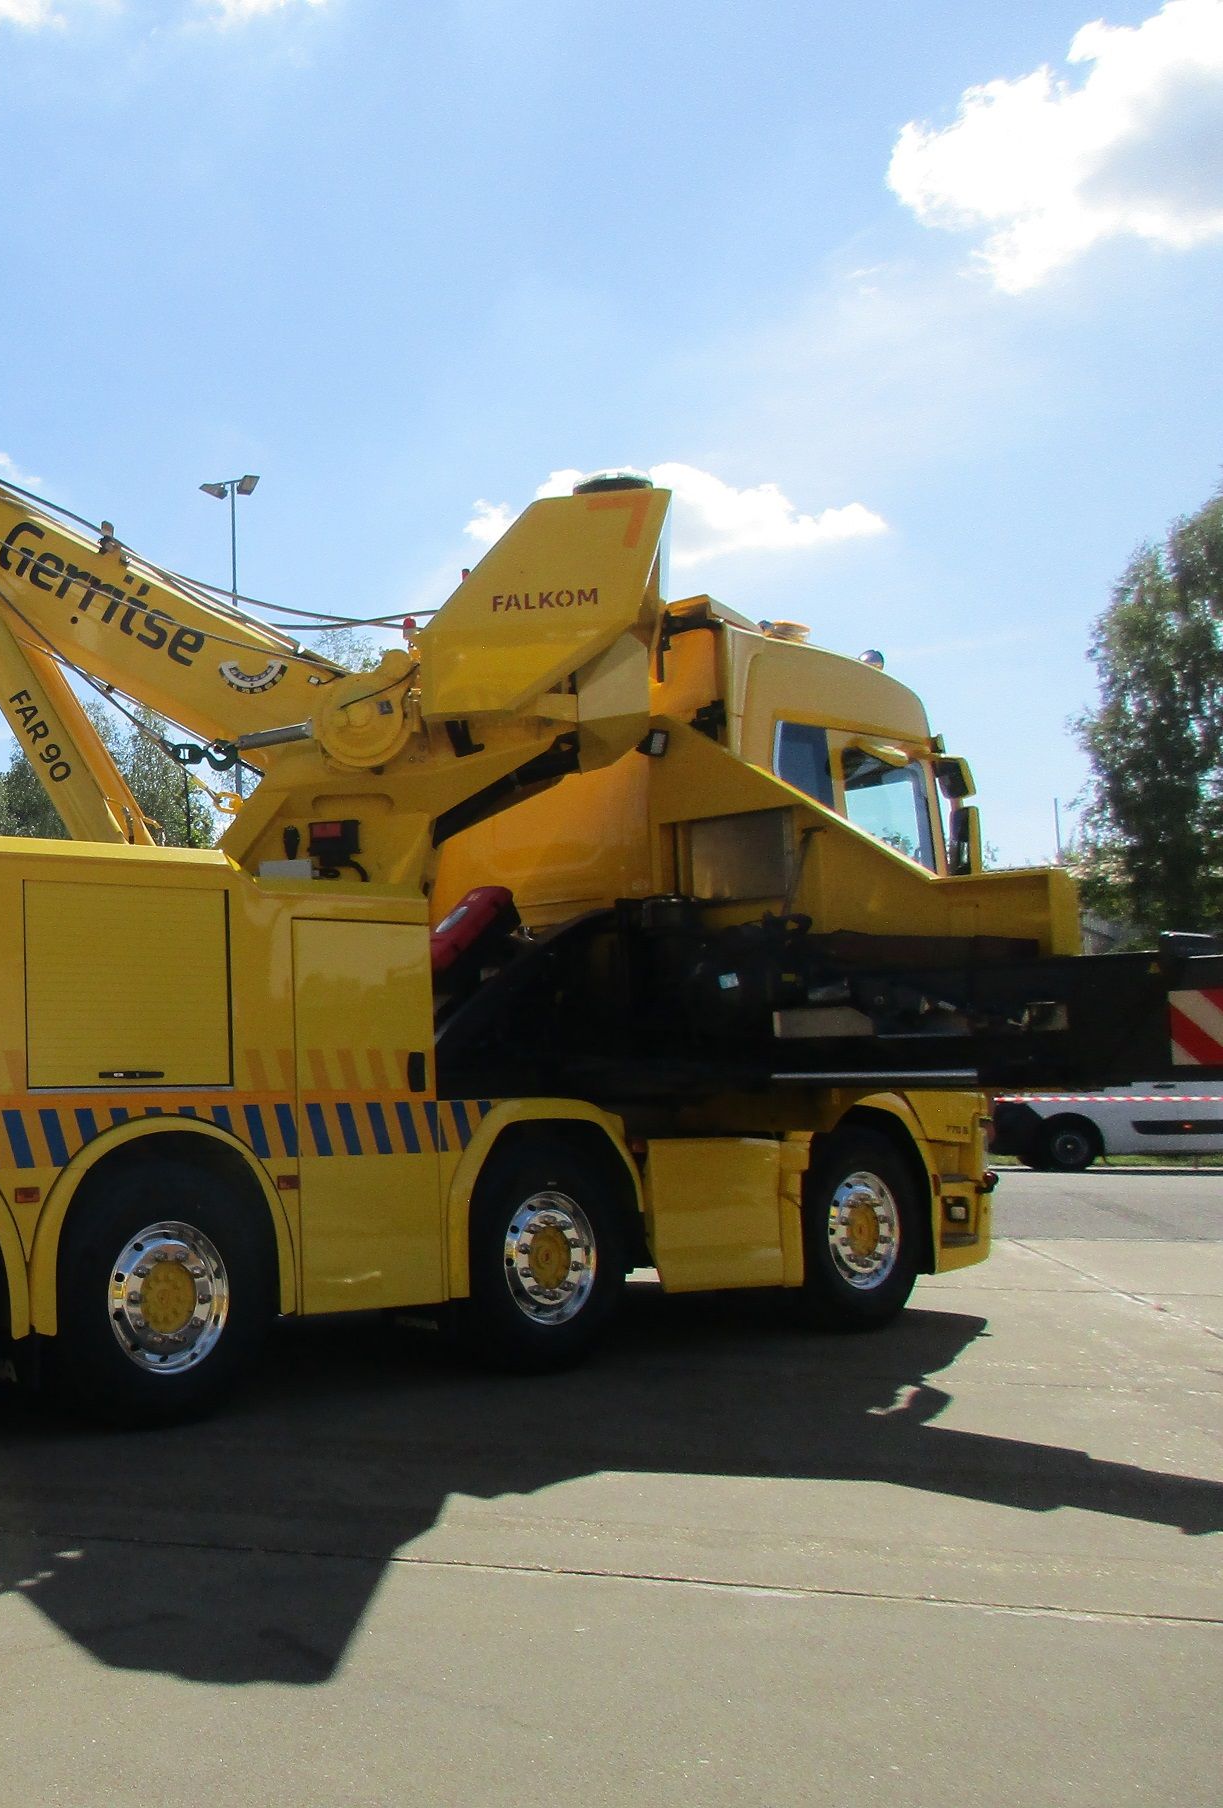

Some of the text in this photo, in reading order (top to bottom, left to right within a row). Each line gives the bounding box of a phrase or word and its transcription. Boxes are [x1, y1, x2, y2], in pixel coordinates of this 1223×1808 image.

[492, 587, 598, 612] FALKOM
[9, 689, 72, 783] FAR 90
